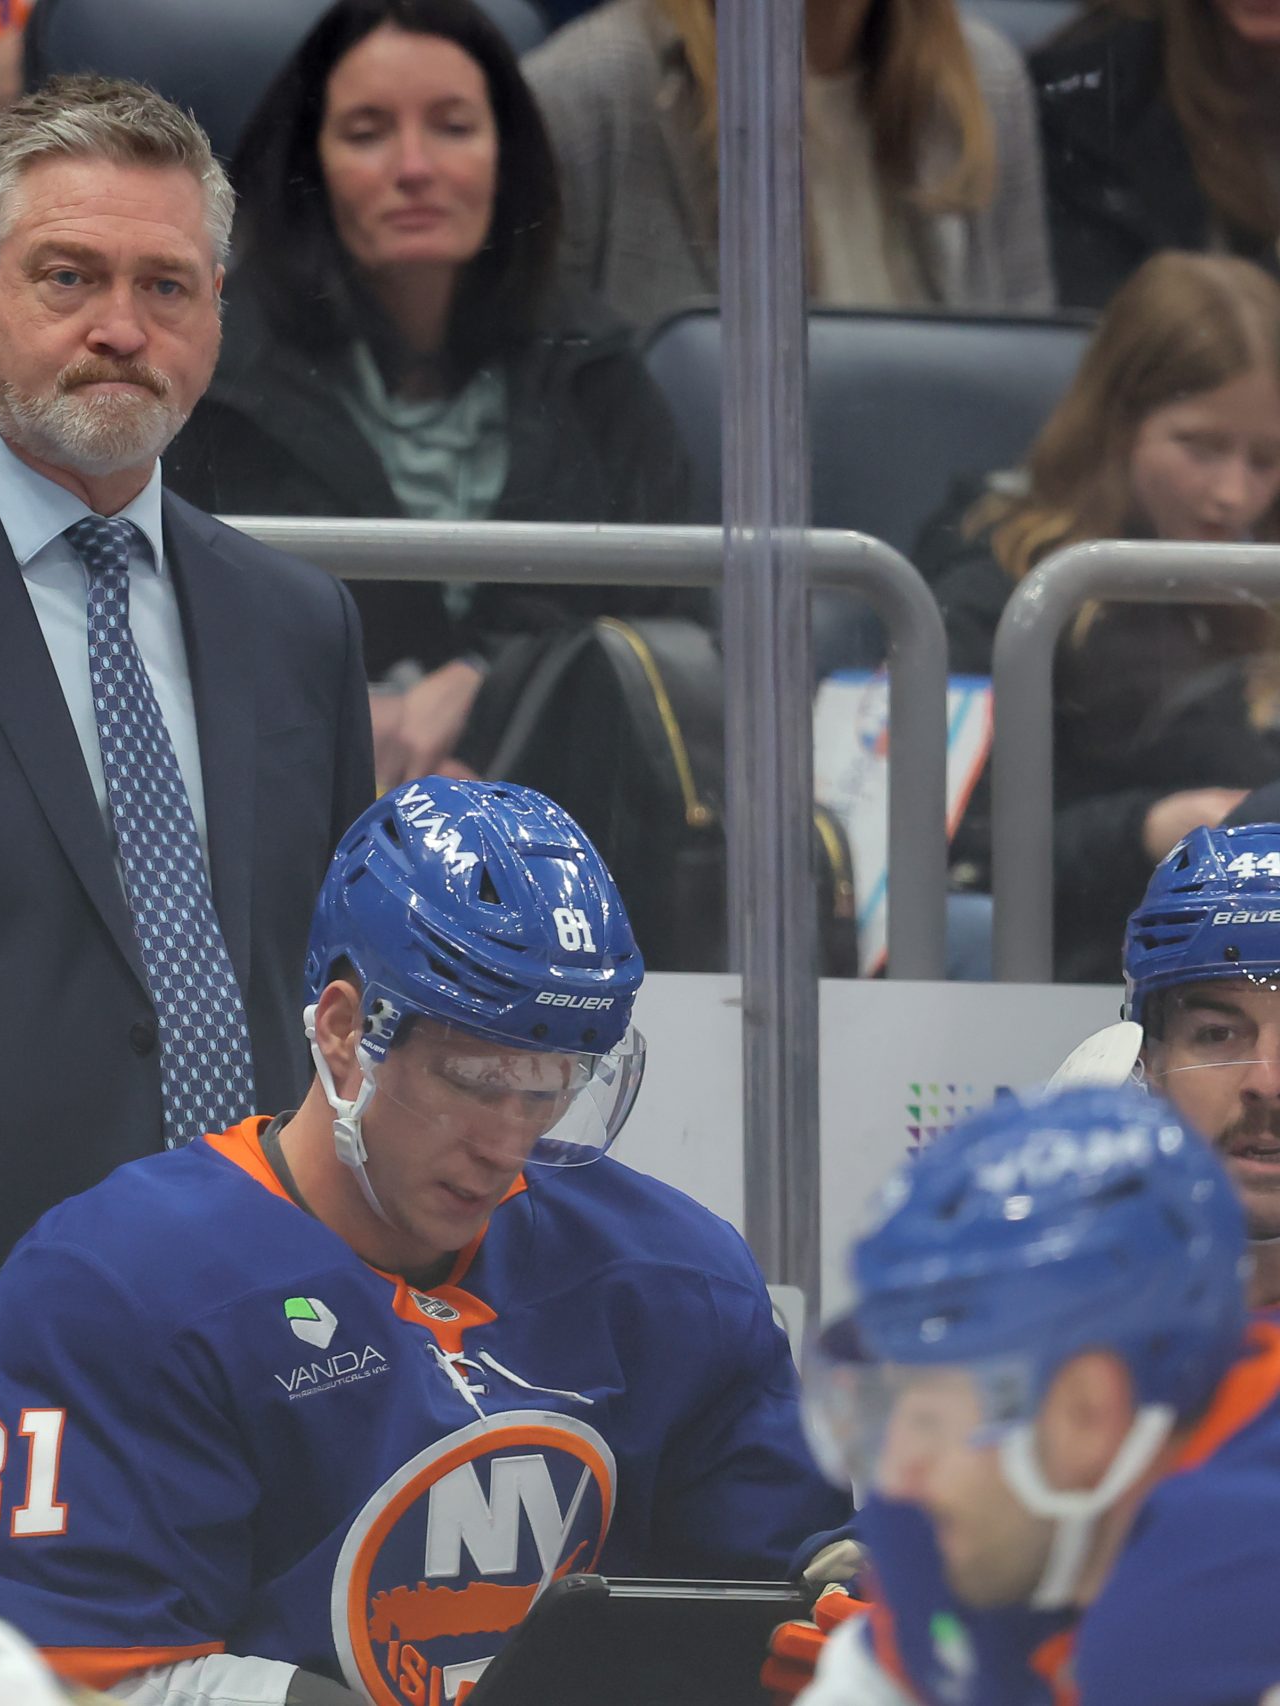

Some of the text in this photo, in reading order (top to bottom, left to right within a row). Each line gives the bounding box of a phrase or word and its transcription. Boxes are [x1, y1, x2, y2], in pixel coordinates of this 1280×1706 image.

[552, 907, 596, 953] 81
[274, 1345, 386, 1391] VANDA
[424, 1453, 592, 1615] NY
